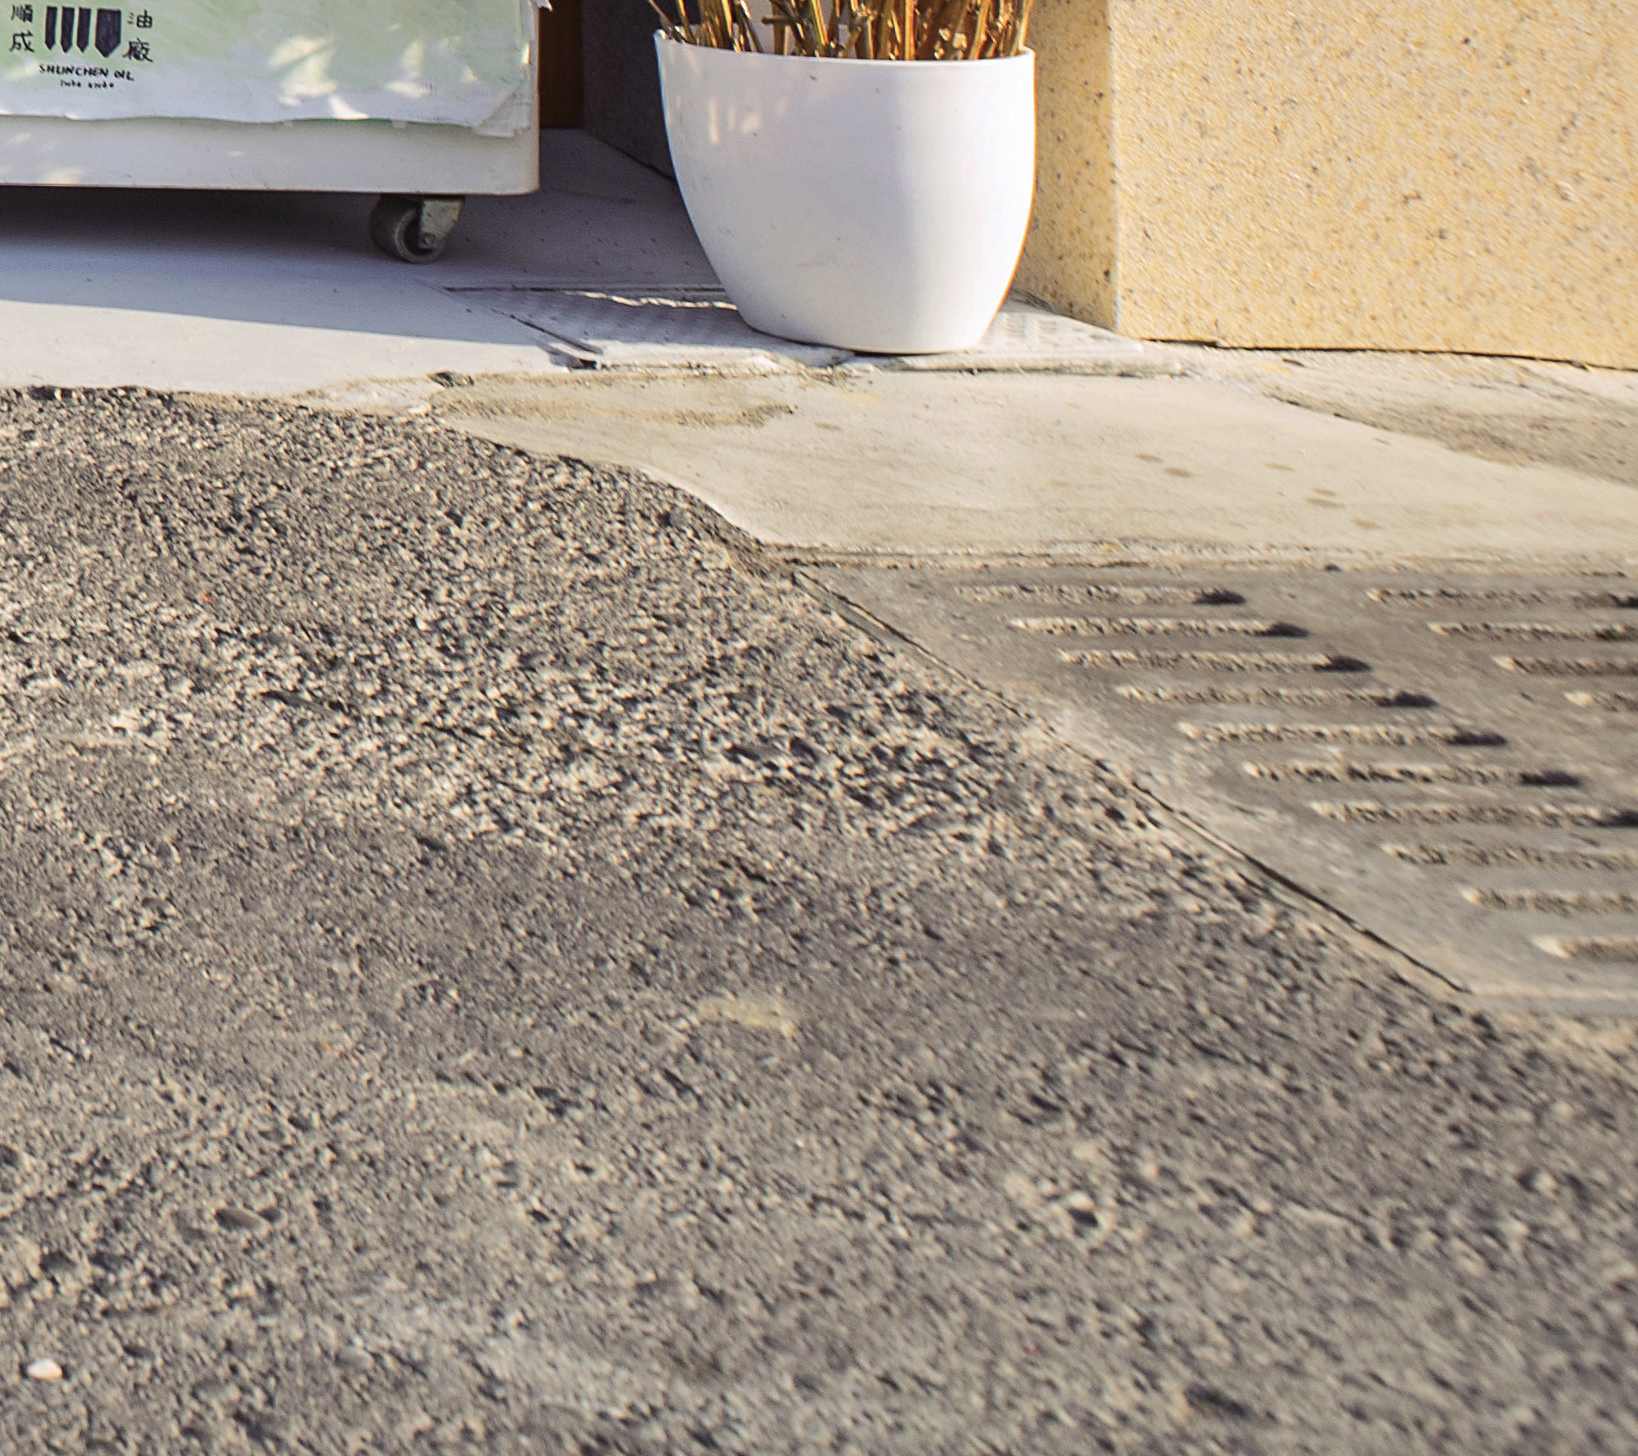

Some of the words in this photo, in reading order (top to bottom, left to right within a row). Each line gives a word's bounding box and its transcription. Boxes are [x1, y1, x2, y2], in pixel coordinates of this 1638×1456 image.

[9, 3, 36, 53] 順成
[122, 8, 154, 64] 油廠
[38, 63, 109, 78] SHUNCHEN
